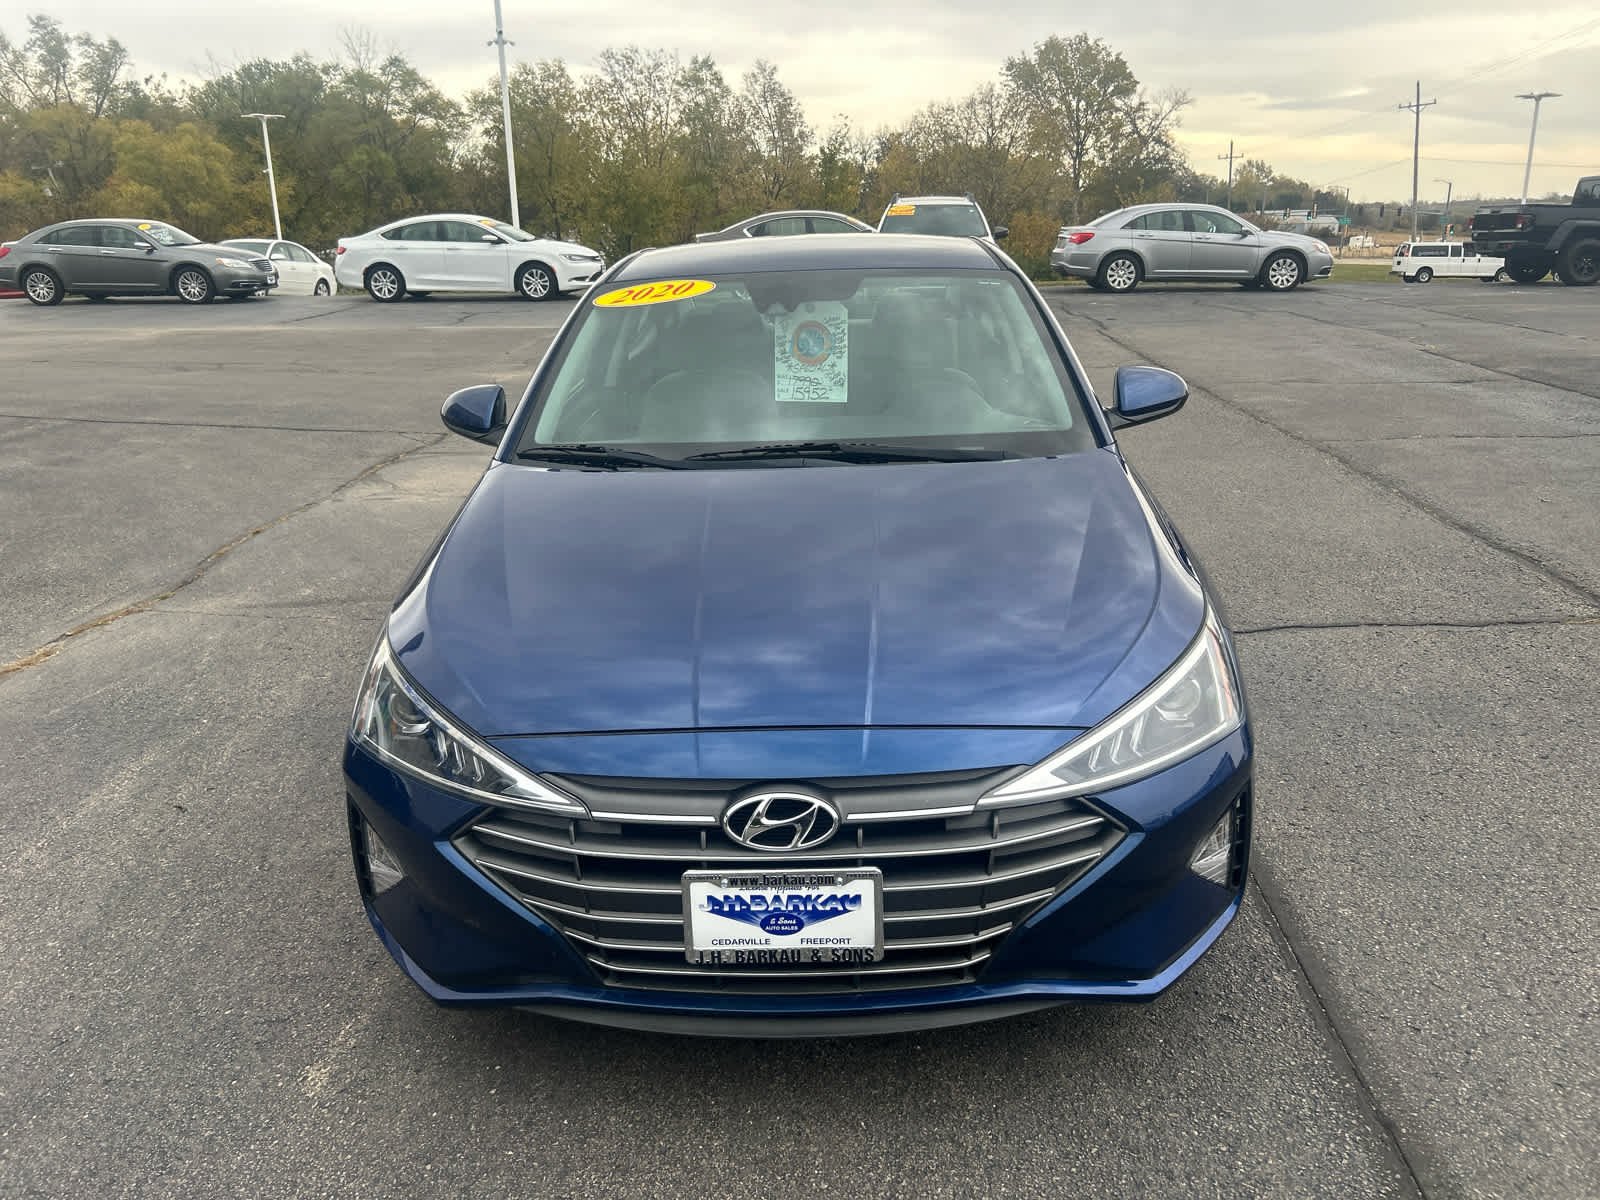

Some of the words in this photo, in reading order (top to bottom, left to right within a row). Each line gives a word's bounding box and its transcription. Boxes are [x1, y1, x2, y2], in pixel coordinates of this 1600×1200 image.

[608, 281, 695, 304] 2020
[729, 873, 835, 886] www.barkau.com
[778, 916, 796, 925] Sons
[711, 938, 771, 946] CEDARVILLE
[800, 937, 852, 945] FREEPORT
[696, 951, 727, 965] J.H.
[735, 949, 801, 963] BARKAU
[811, 948, 822, 962] &
[831, 947, 874, 962] SONS
